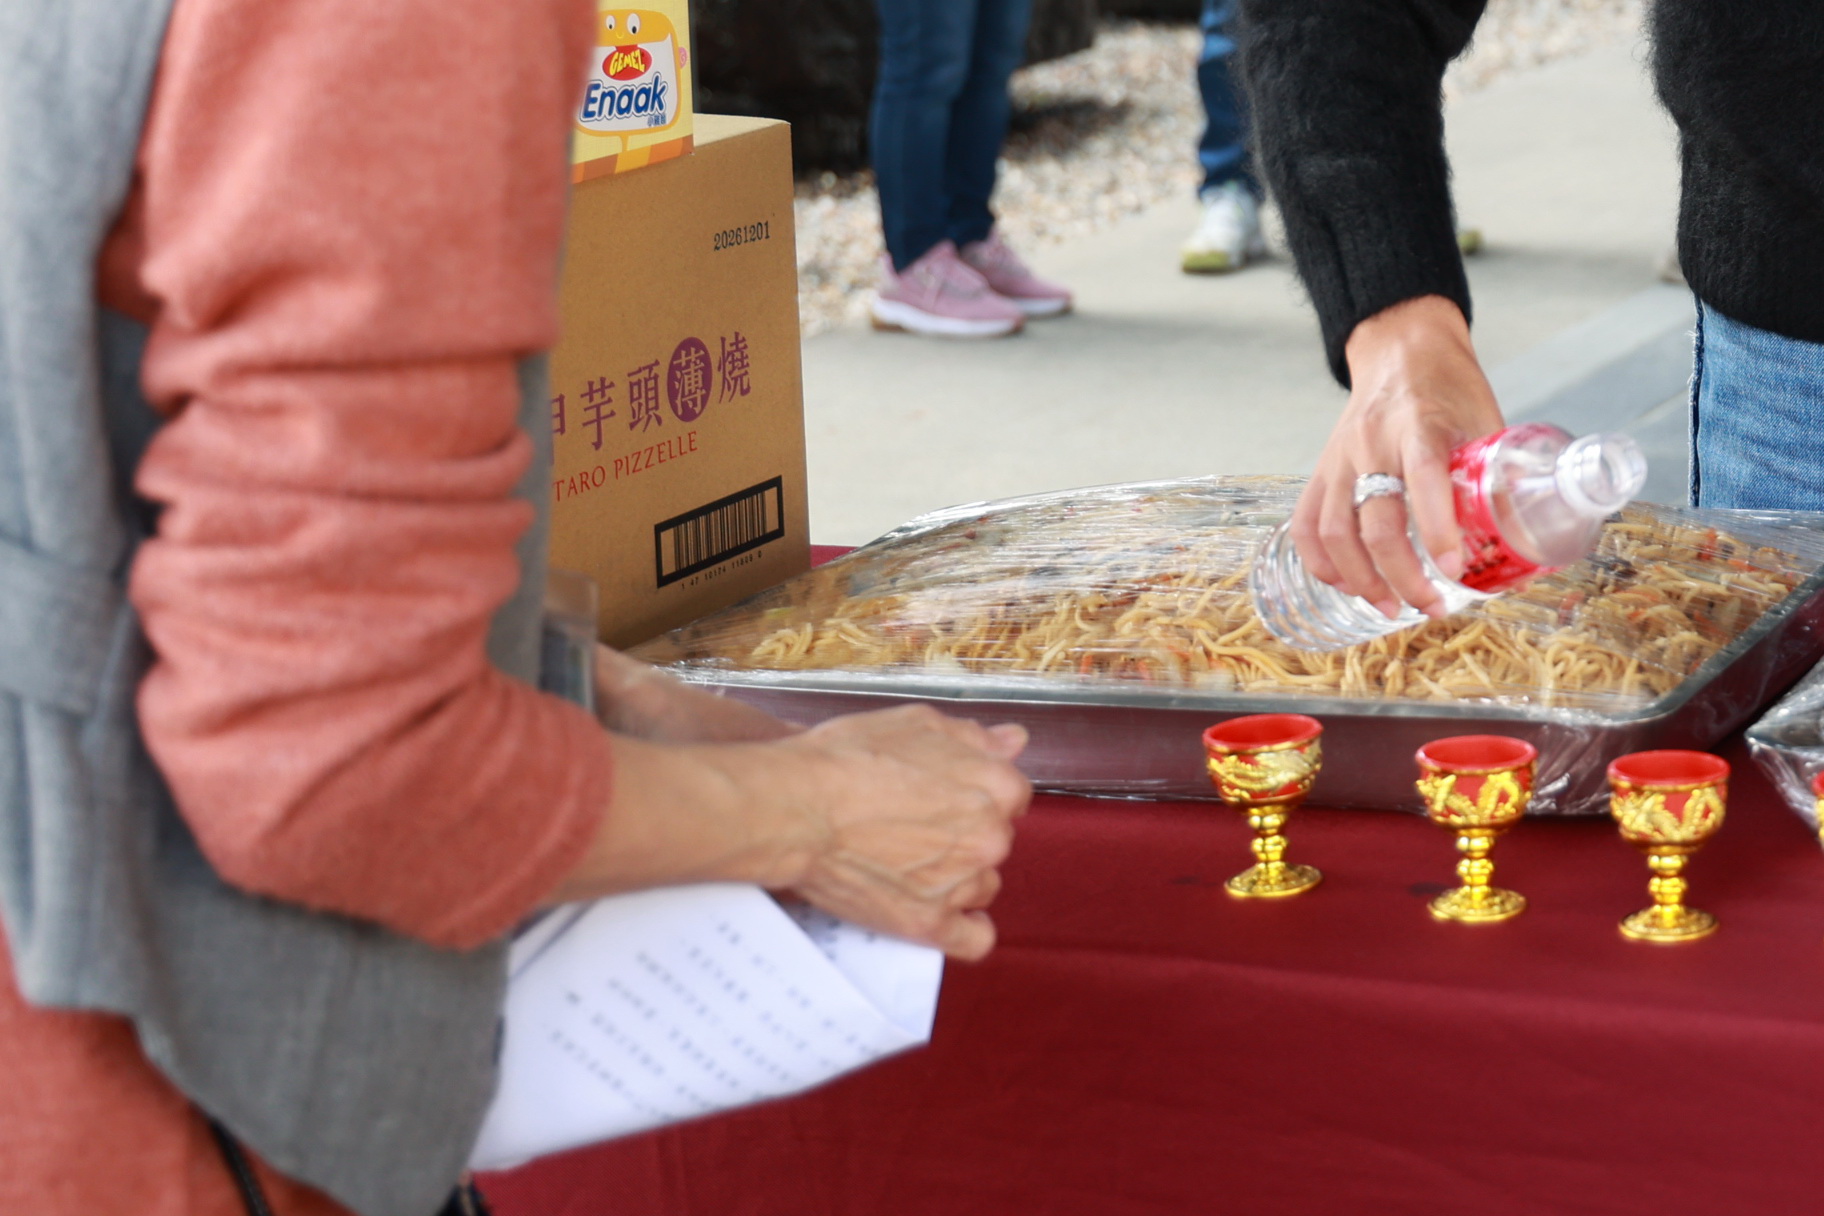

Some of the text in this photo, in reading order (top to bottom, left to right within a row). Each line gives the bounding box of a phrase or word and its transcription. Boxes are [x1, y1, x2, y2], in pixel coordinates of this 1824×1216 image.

[609, 49, 646, 77] GEMEZ
[581, 73, 667, 120] Enaak
[713, 220, 770, 251] 20261201
[552, 431, 699, 502] TARO PIZZELLE
